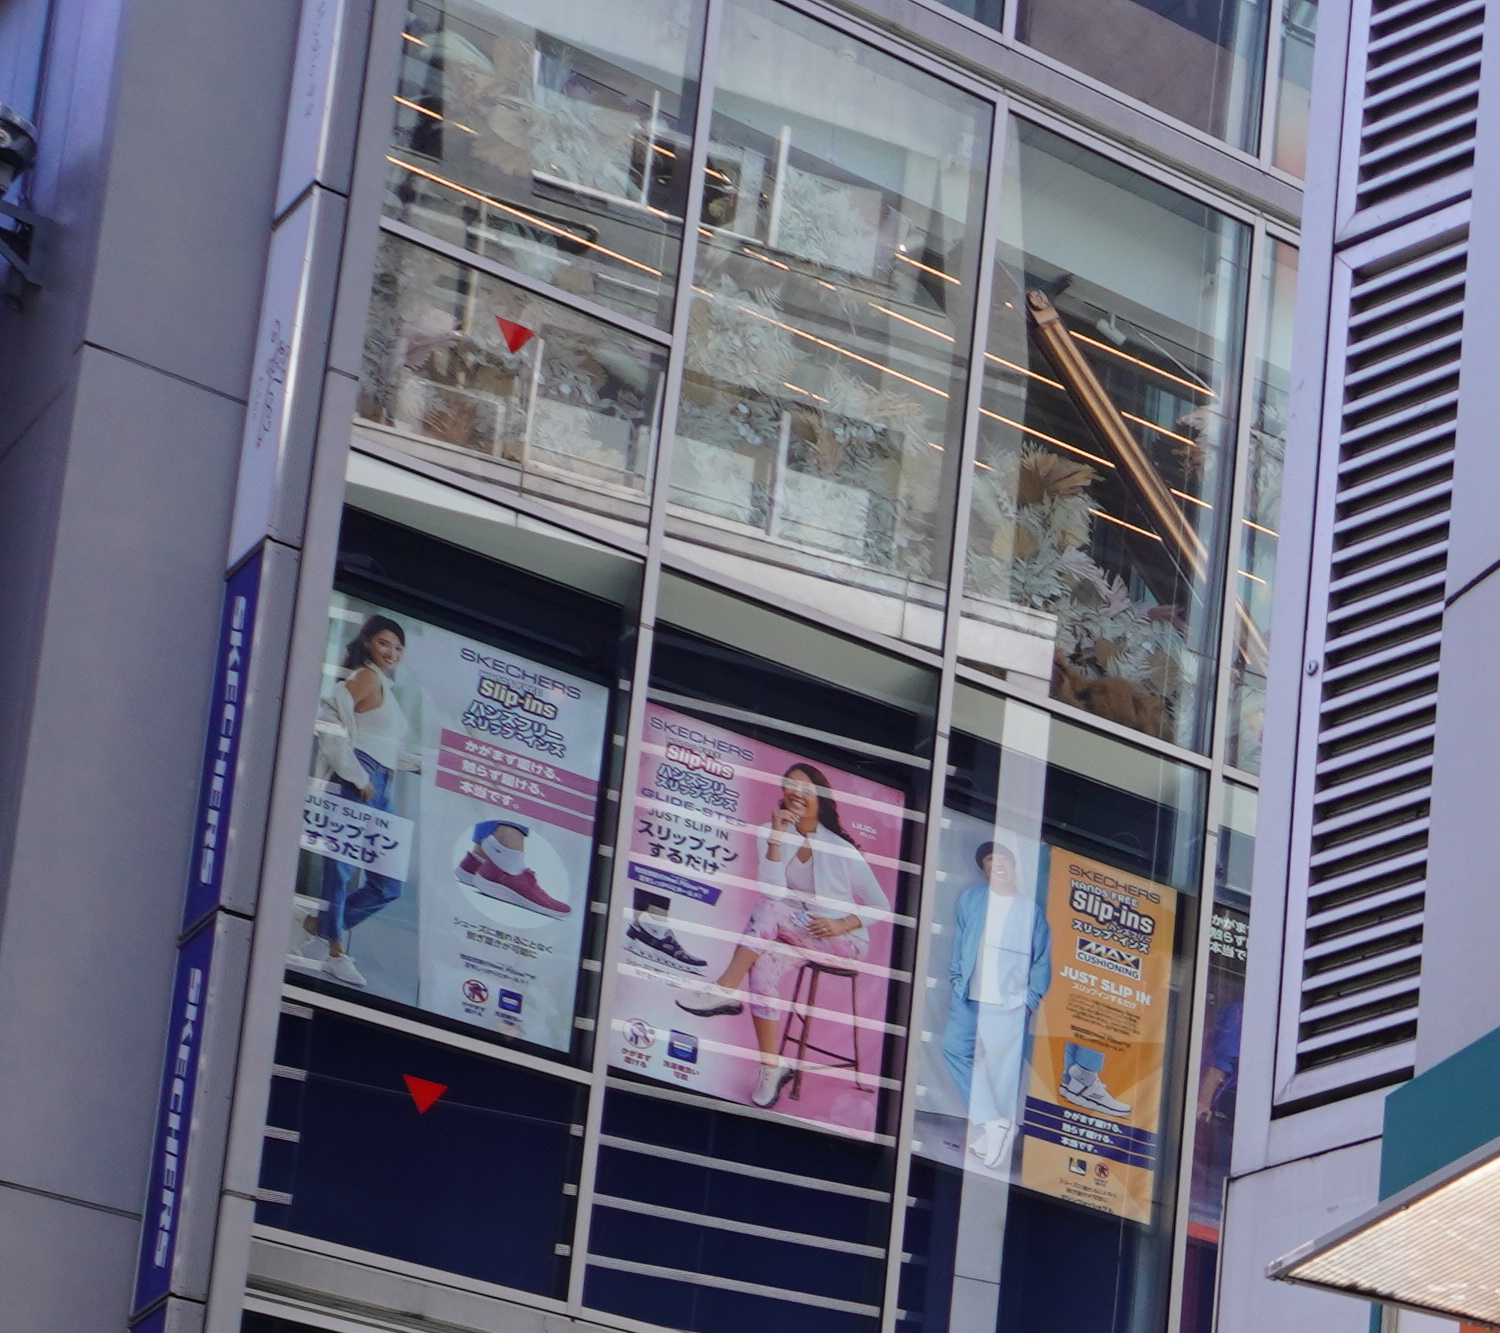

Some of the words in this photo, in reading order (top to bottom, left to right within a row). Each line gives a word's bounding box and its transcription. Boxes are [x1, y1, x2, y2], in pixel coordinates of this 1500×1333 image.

[460, 647, 582, 700] SKECHERS
[478, 677, 558, 720] Slip-ins
[200, 595, 247, 886] SKECHERS
[469, 700, 565, 742] ハンズフリー
[650, 716, 755, 761] SKECHERS
[665, 743, 735, 780] Slip-ins
[305, 795, 338, 816] JUST
[341, 805, 371, 823] SLIP
[375, 815, 390, 830] IN
[648, 808, 681, 826] JUST
[685, 818, 713, 834] SLIP
[716, 828, 729, 841] IN
[637, 818, 738, 863] スリップイン
[1069, 864, 1161, 905] SKECHERS
[1070, 879, 1109, 898] HANDS
[1111, 890, 1139, 908] FREE
[1070, 890, 1156, 934] Slip-ins
[1077, 952, 1140, 980] CUSHIONING
[1080, 941, 1141, 969] MAX
[1059, 965, 1098, 987] JUST
[1100, 978, 1134, 998] SLIP
[1135, 988, 1152, 1006] IN
[152, 967, 202, 1270] SKECHERS
